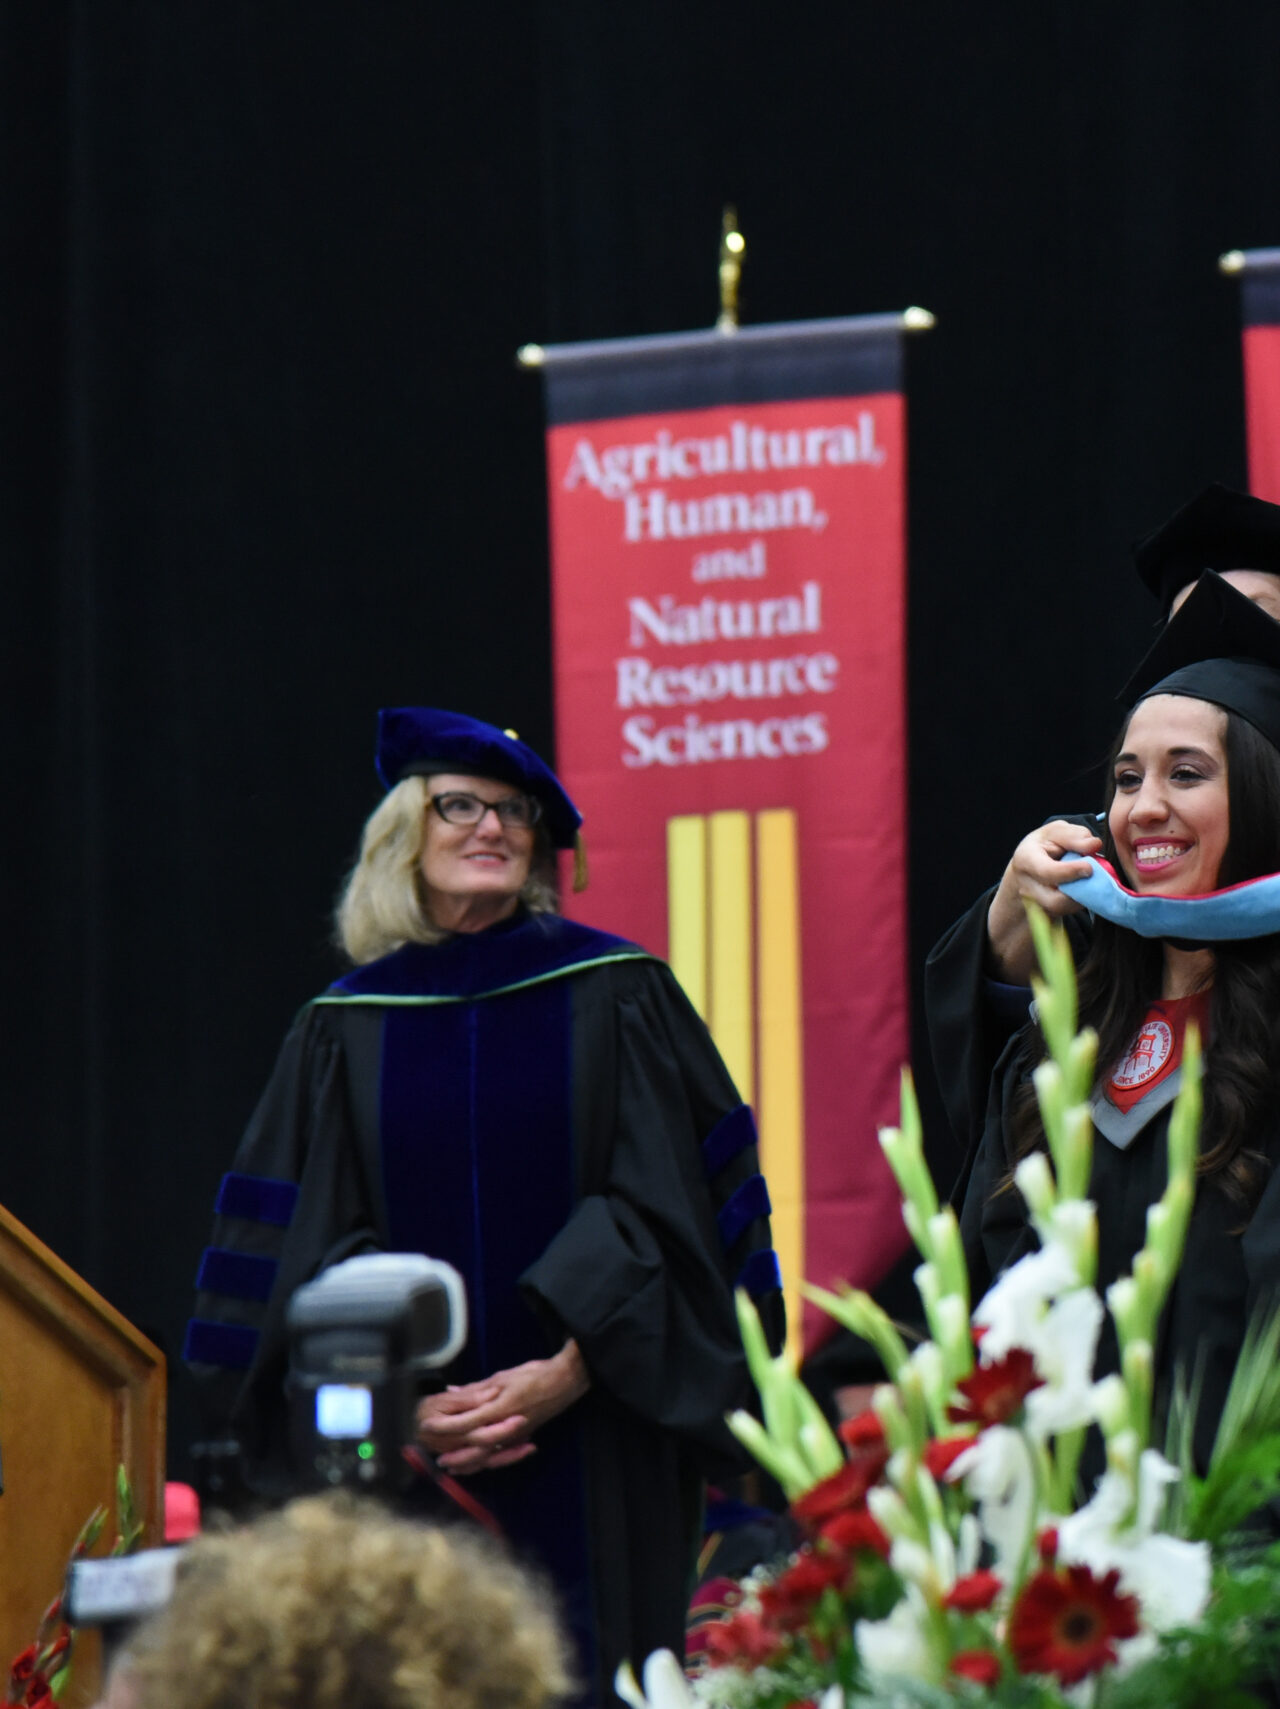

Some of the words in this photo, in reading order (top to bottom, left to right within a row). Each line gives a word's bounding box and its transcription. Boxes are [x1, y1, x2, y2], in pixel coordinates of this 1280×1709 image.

[563, 411, 886, 498] Agricultural,
[622, 487, 828, 542] Human,
[691, 539, 767, 584] and
[628, 580, 821, 649] Natural
[615, 652, 840, 709] Resource
[622, 712, 829, 770] Sciences
[1138, 1066, 1156, 1081] 1890
